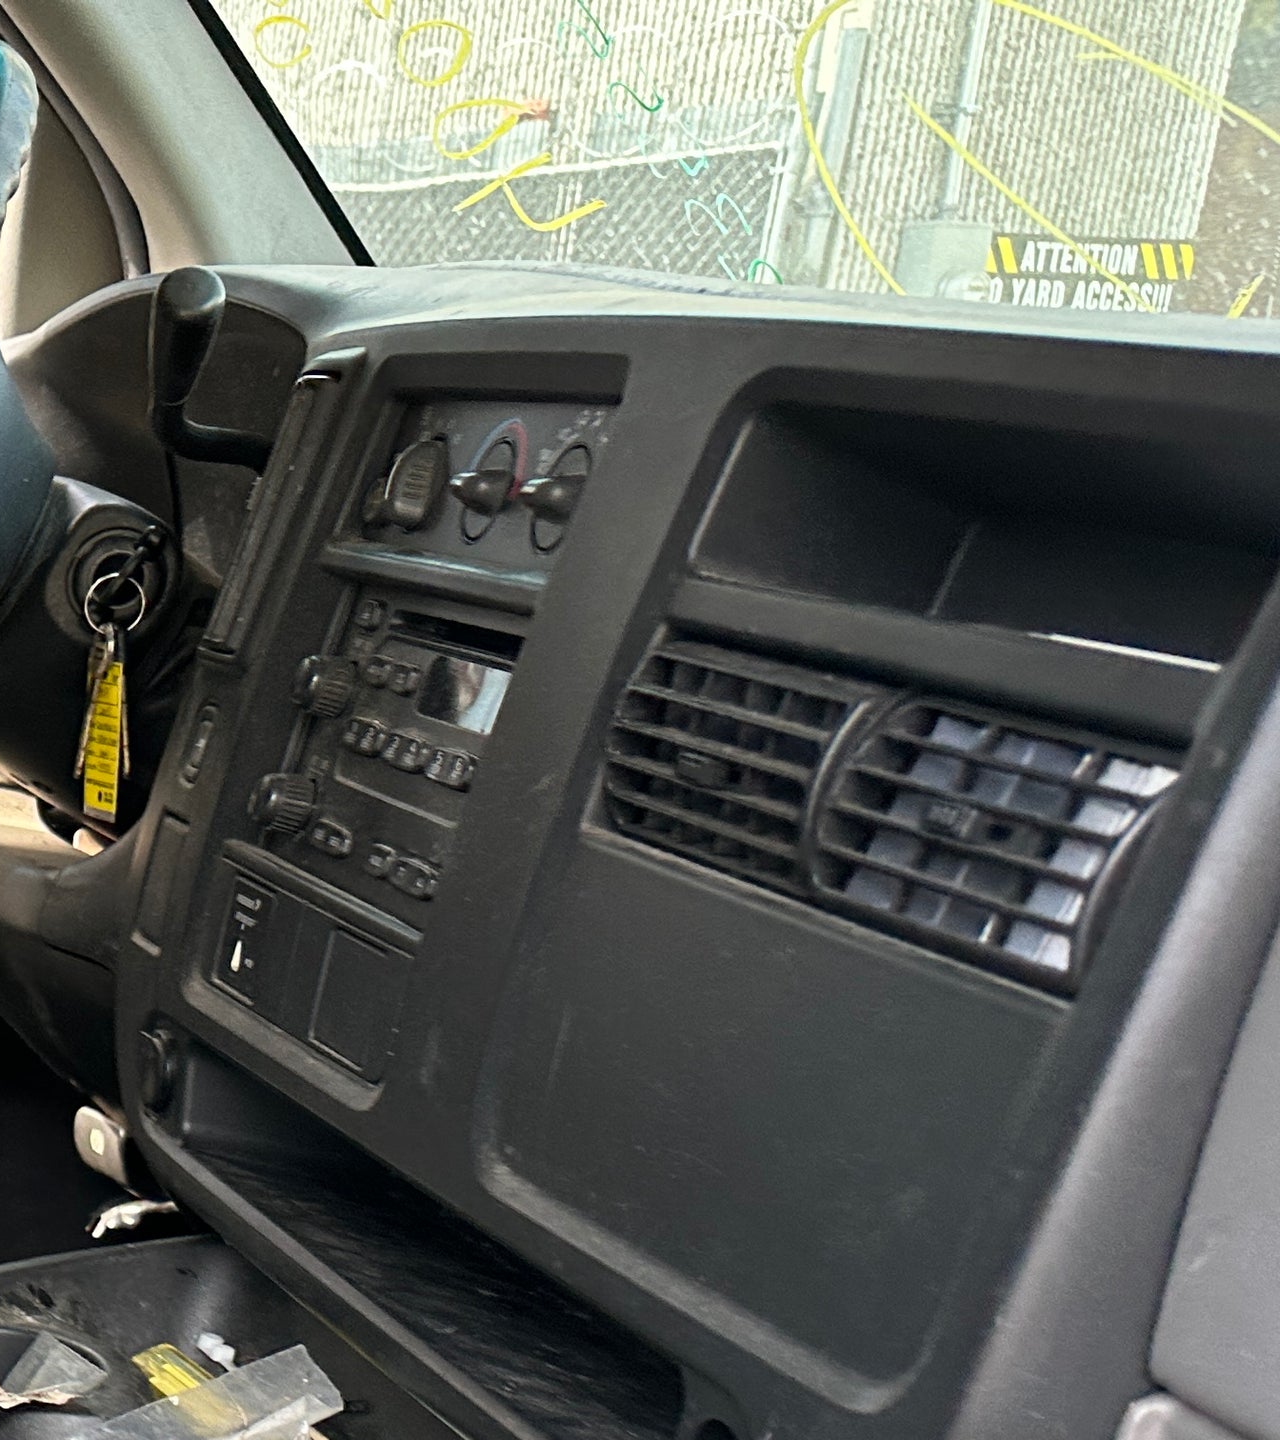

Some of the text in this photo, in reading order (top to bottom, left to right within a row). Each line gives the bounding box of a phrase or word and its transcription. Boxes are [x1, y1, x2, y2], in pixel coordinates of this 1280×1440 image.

[1020, 241, 1139, 277] ATTENTION
[1011, 279, 1065, 309] YARD
[1070, 283, 1175, 315] ACCESS!!!
